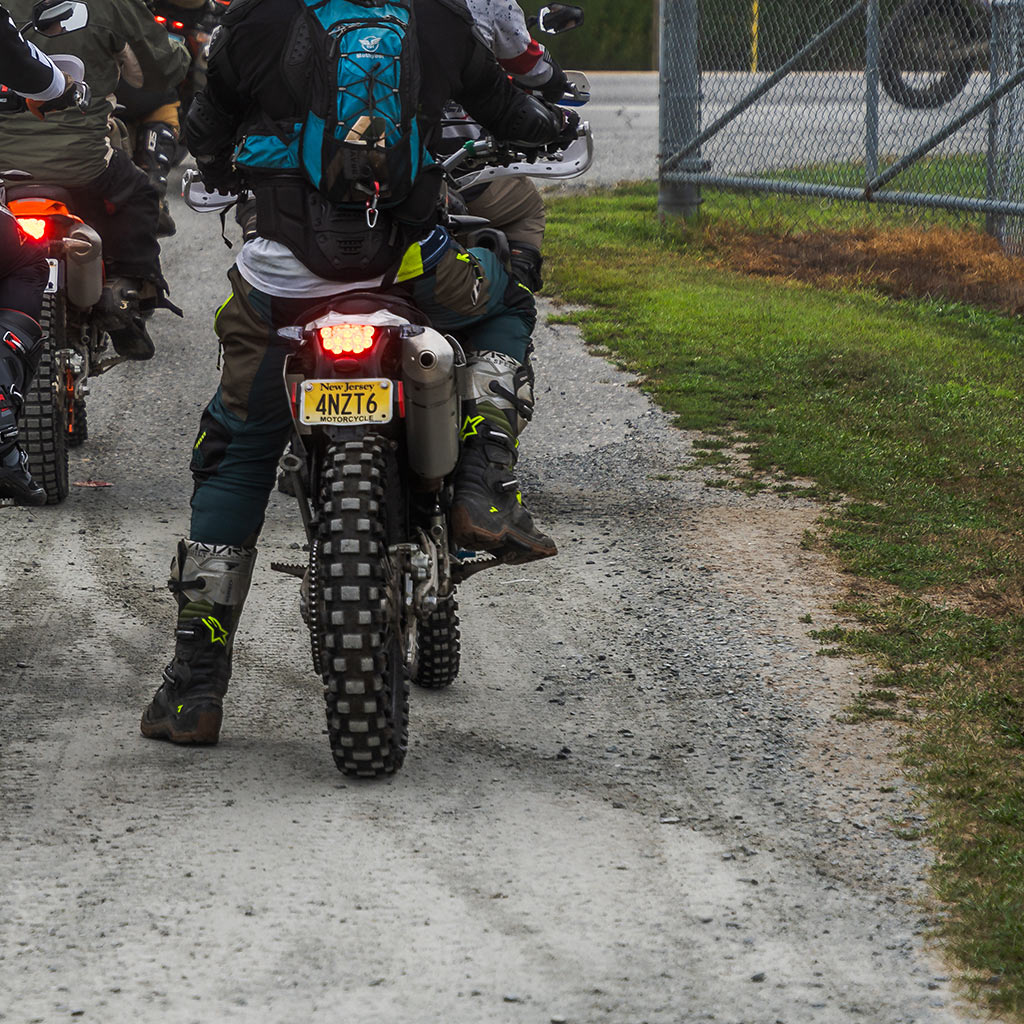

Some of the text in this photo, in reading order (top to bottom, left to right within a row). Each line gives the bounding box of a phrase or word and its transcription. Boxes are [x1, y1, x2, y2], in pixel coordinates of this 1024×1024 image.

[320, 383, 375, 392] New Jersey
[316, 393, 377, 415] 4NZT6
[320, 415, 373, 423] MOTORCYCLE
